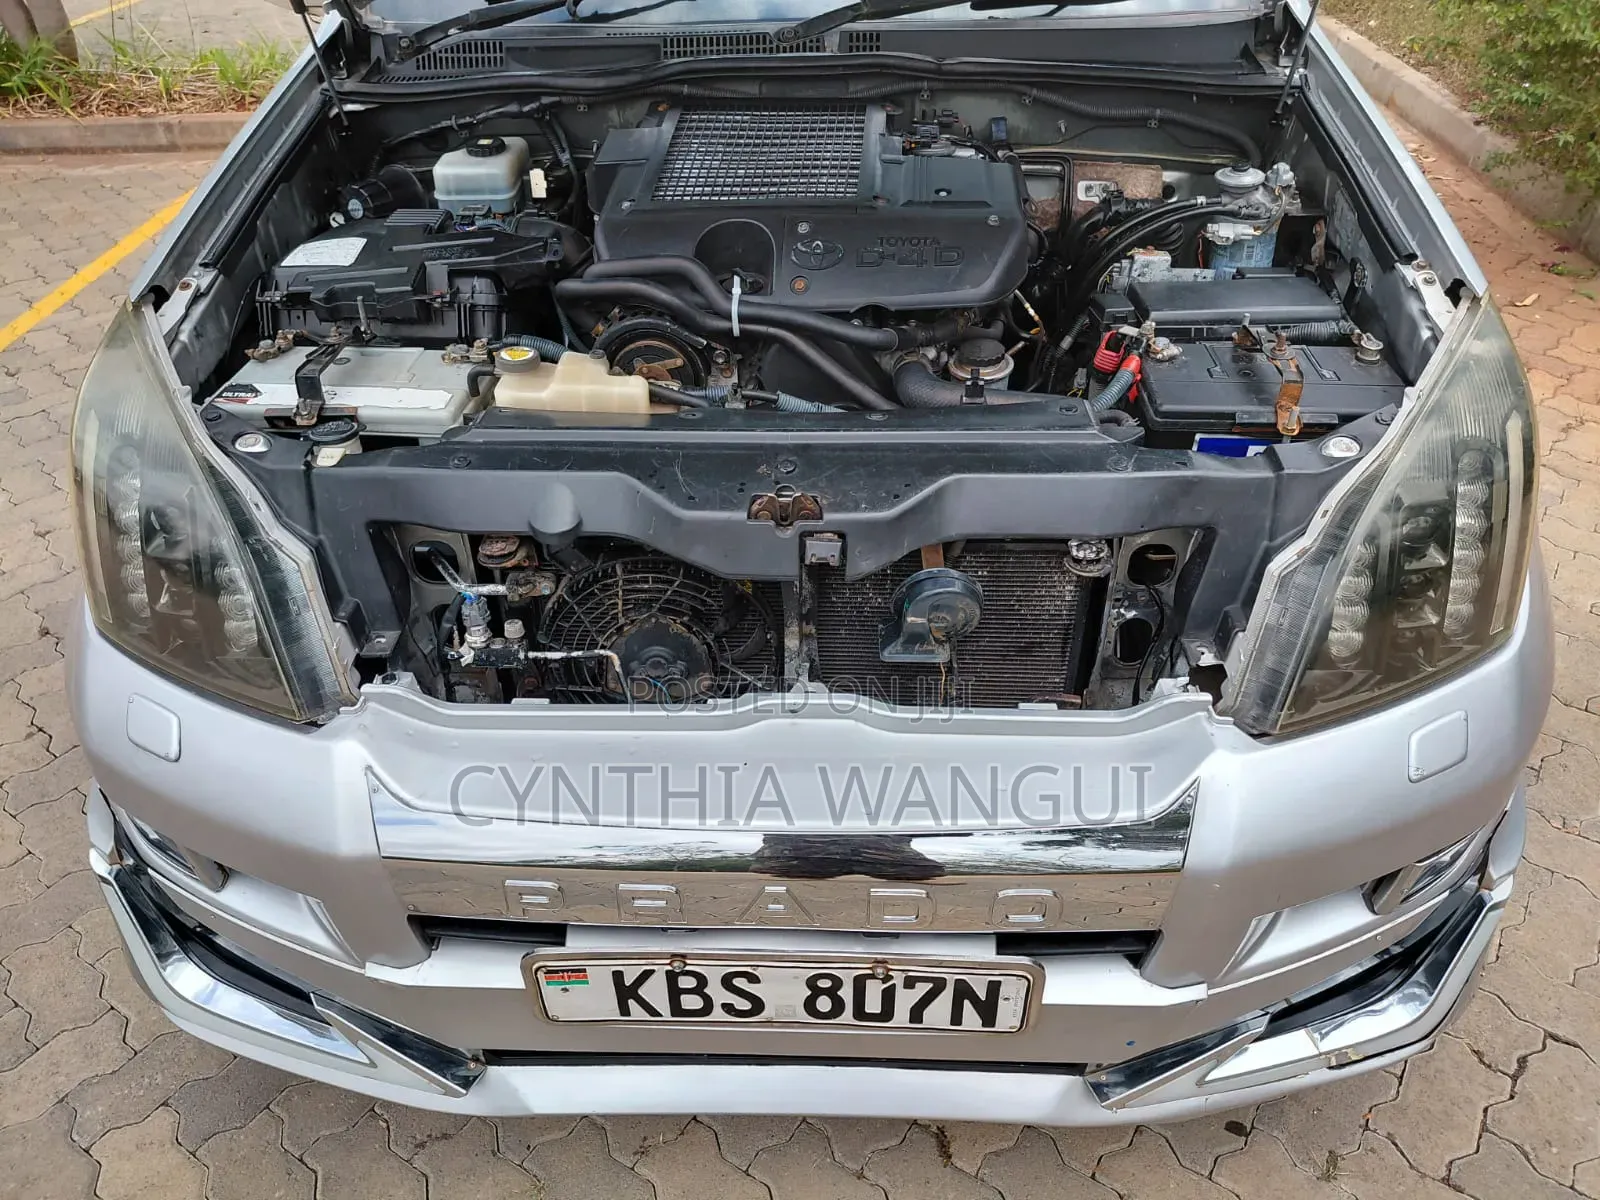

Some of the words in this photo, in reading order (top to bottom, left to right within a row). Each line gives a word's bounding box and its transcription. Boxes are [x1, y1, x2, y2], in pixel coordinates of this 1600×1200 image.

[855, 245, 966, 268] D-4D
[876, 236, 942, 248] TOYOTA
[502, 879, 1064, 928] PRADO
[611, 969, 766, 1018] KBS
[803, 972, 1002, 1028] 807N
